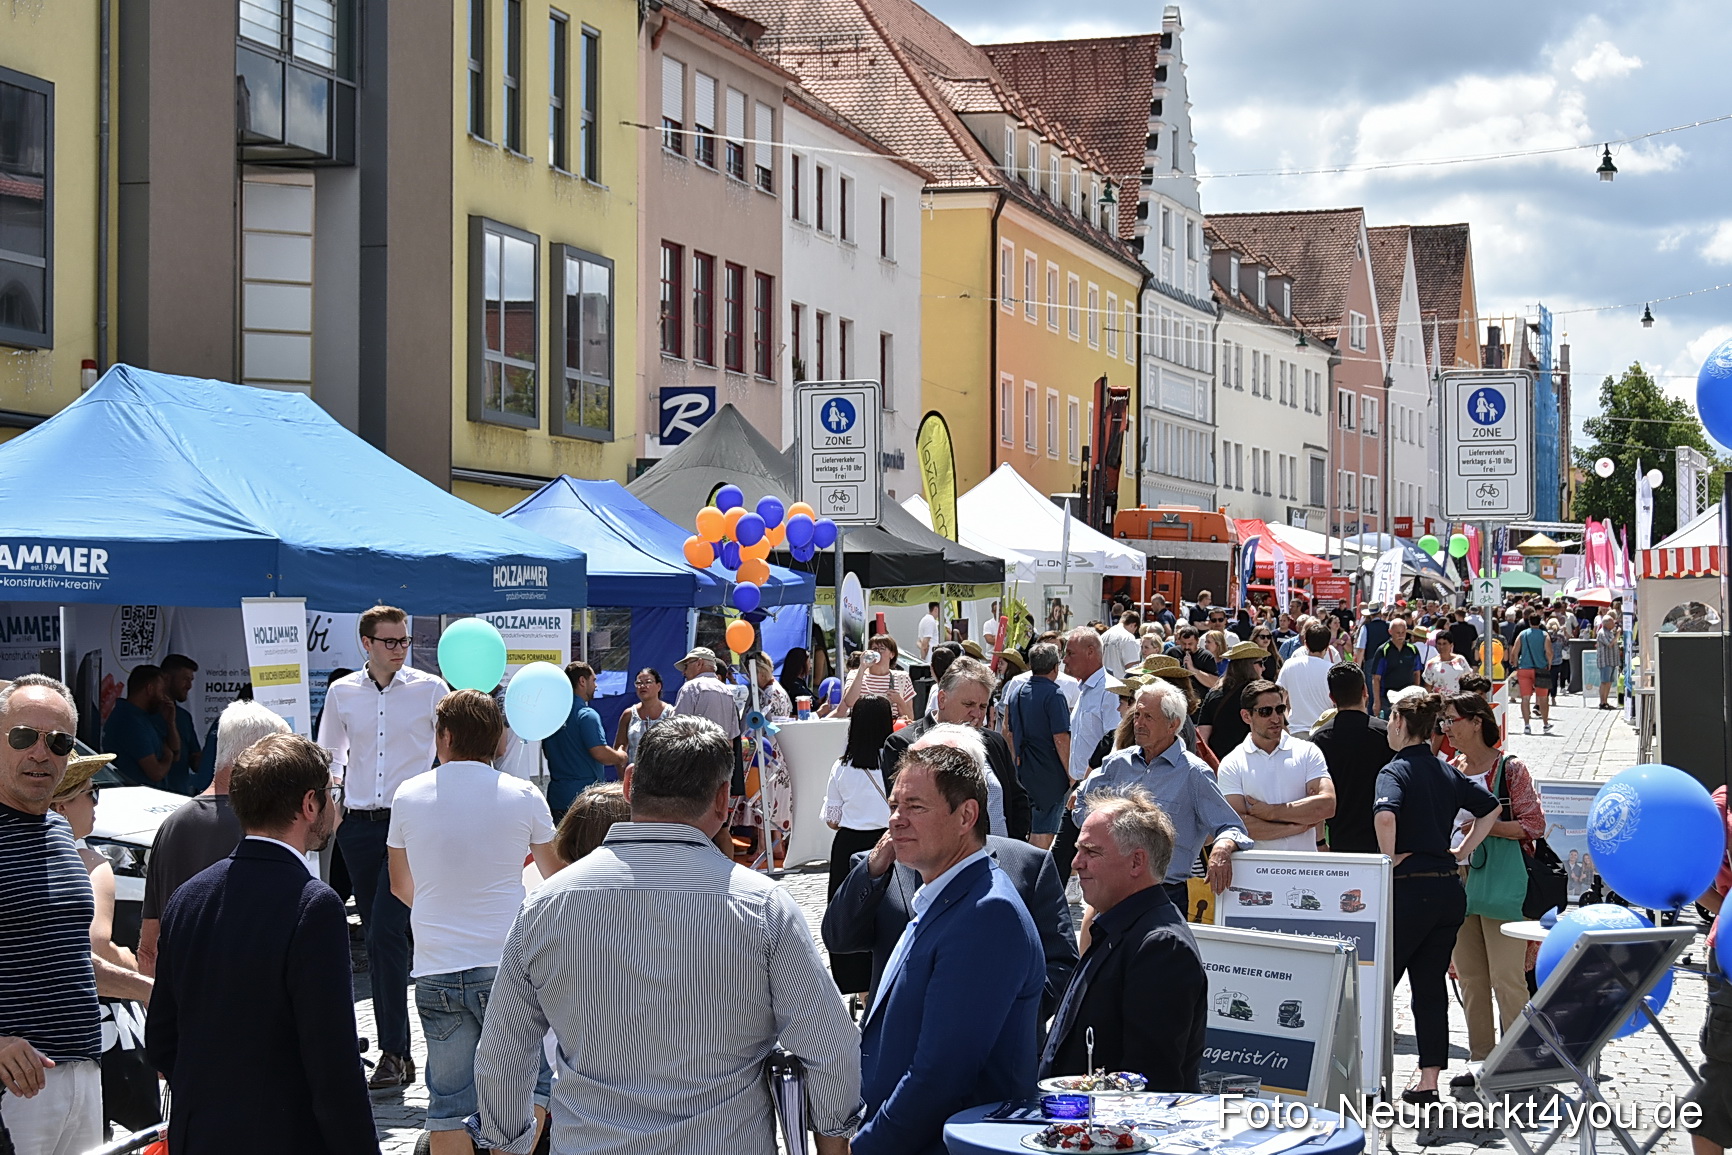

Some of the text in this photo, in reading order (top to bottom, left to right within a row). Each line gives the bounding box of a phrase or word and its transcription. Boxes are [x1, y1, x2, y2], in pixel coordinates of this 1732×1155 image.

[1472, 428, 1502, 437] ZONE
[825, 436, 852, 446] ZONE
[1468, 449, 1506, 457] Lieferverkehr
[1462, 458, 1487, 466] werktags
[815, 465, 838, 473] werktags
[493, 565, 548, 587] HOLZAMMER
[485, 615, 561, 630] HOLZAMMER
[253, 626, 299, 644] HOLZAMMER
[527, 653, 557, 661] FORMENBAU
[1605, 815, 1616, 829] 40
[1232, 966, 1263, 977] MEIER
[1265, 970, 1292, 981] GMBH
